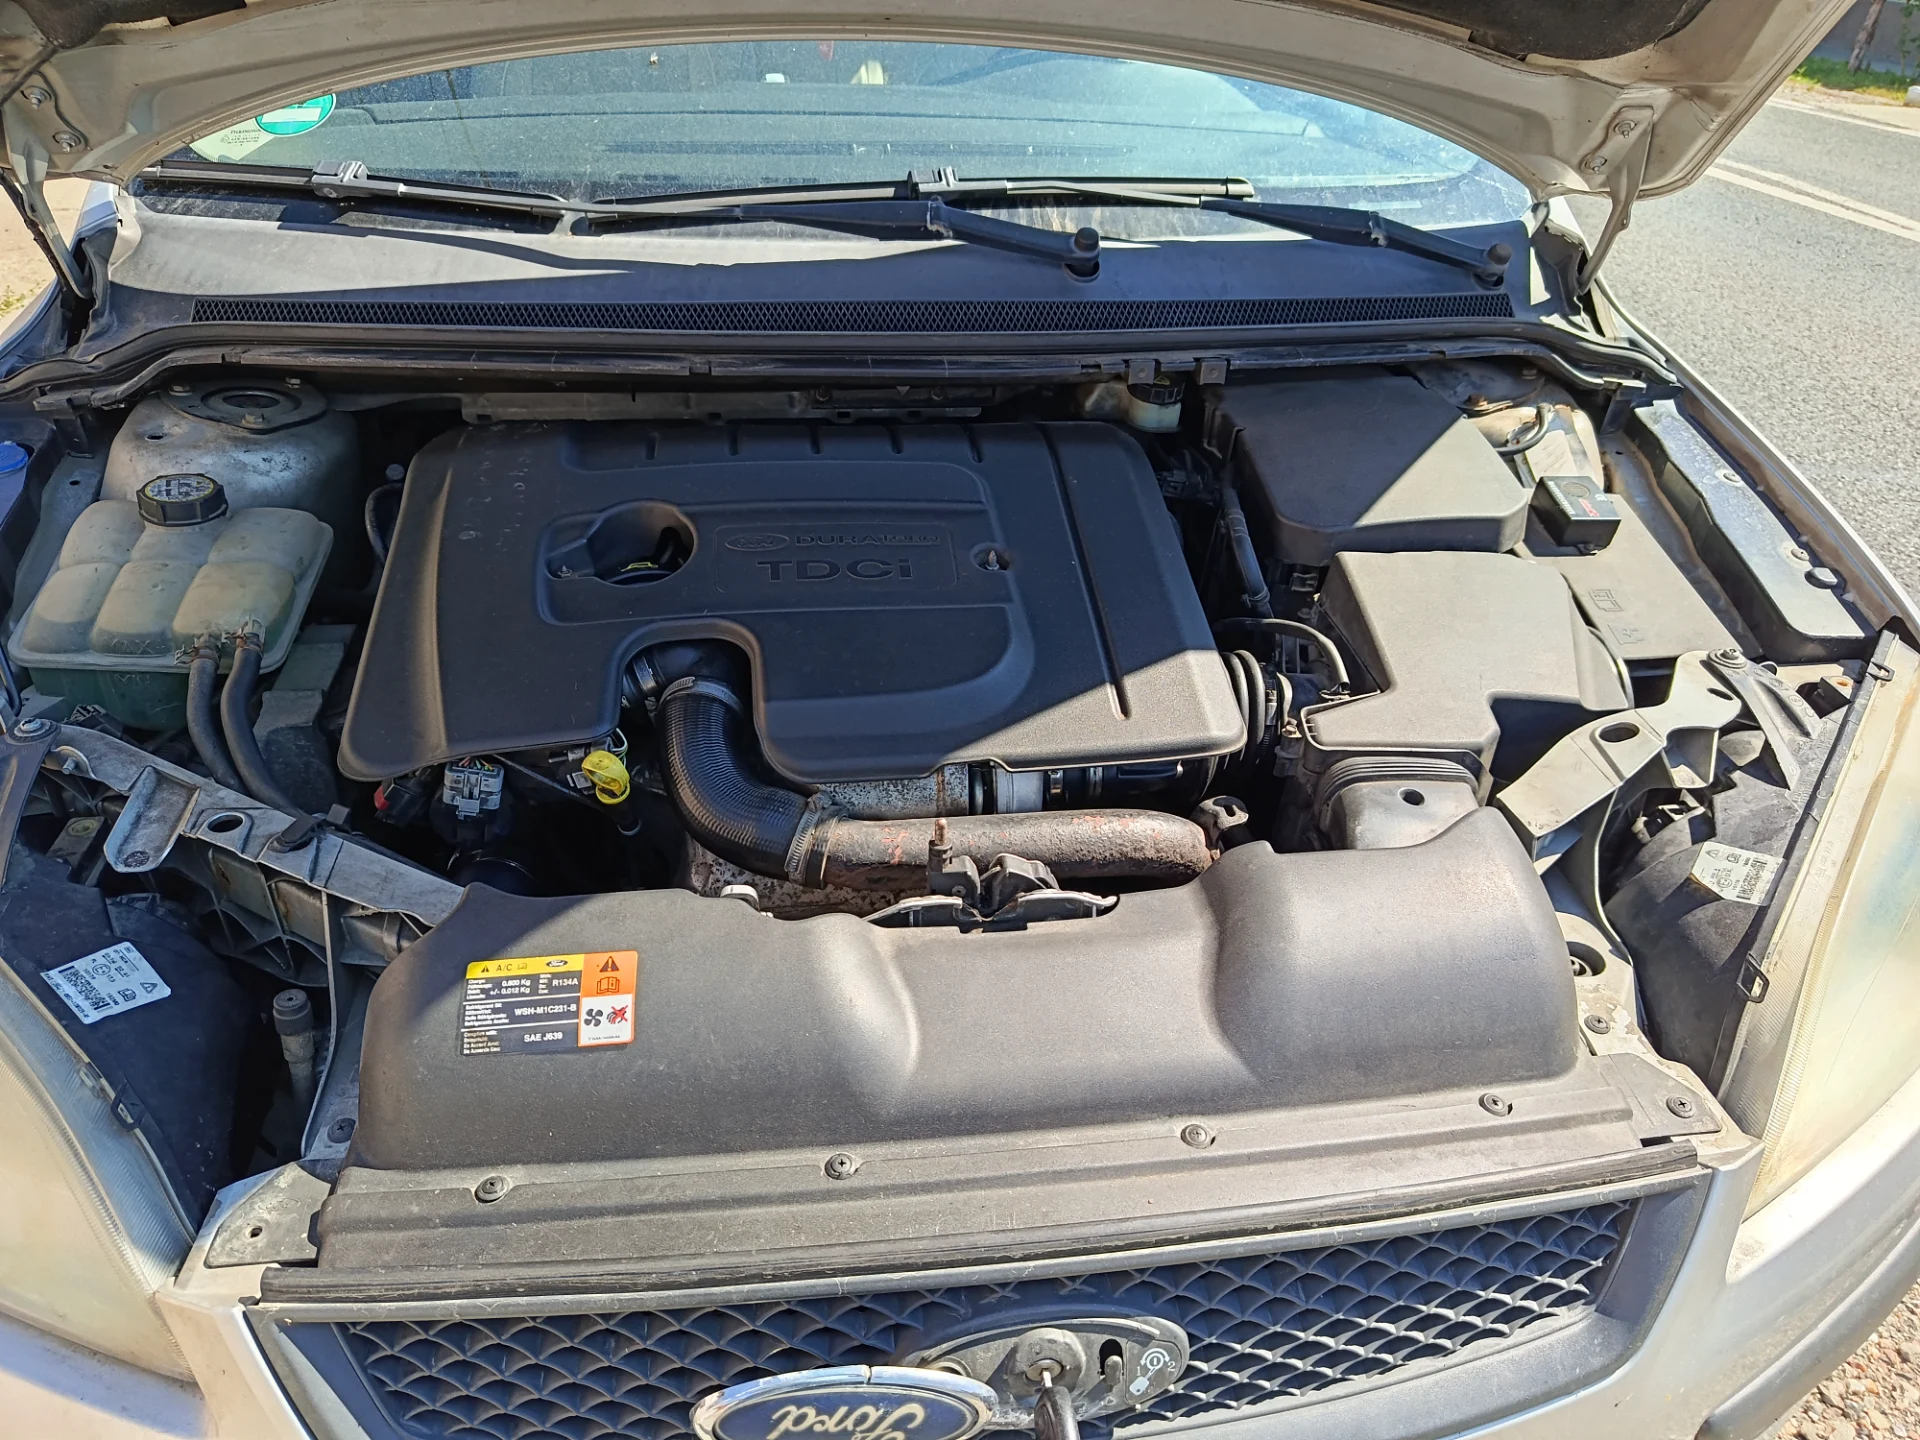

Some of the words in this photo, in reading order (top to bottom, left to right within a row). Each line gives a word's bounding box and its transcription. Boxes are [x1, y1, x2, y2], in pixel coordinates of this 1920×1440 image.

[757, 558, 913, 582] TDCi
[495, 963, 513, 973] A/C
[520, 978, 531, 988] Kg
[552, 977, 579, 988] R134A
[501, 987, 520, 996] 0.012
[520, 986, 531, 995] Kg
[514, 1003, 577, 1016] WSH-M1C231-B
[523, 1033, 542, 1043] SAE
[543, 1031, 563, 1042] J639
[1136, 1365, 1142, 1377] 1
[1166, 1360, 1176, 1372] 2
[766, 1402, 925, 1440] Ford
